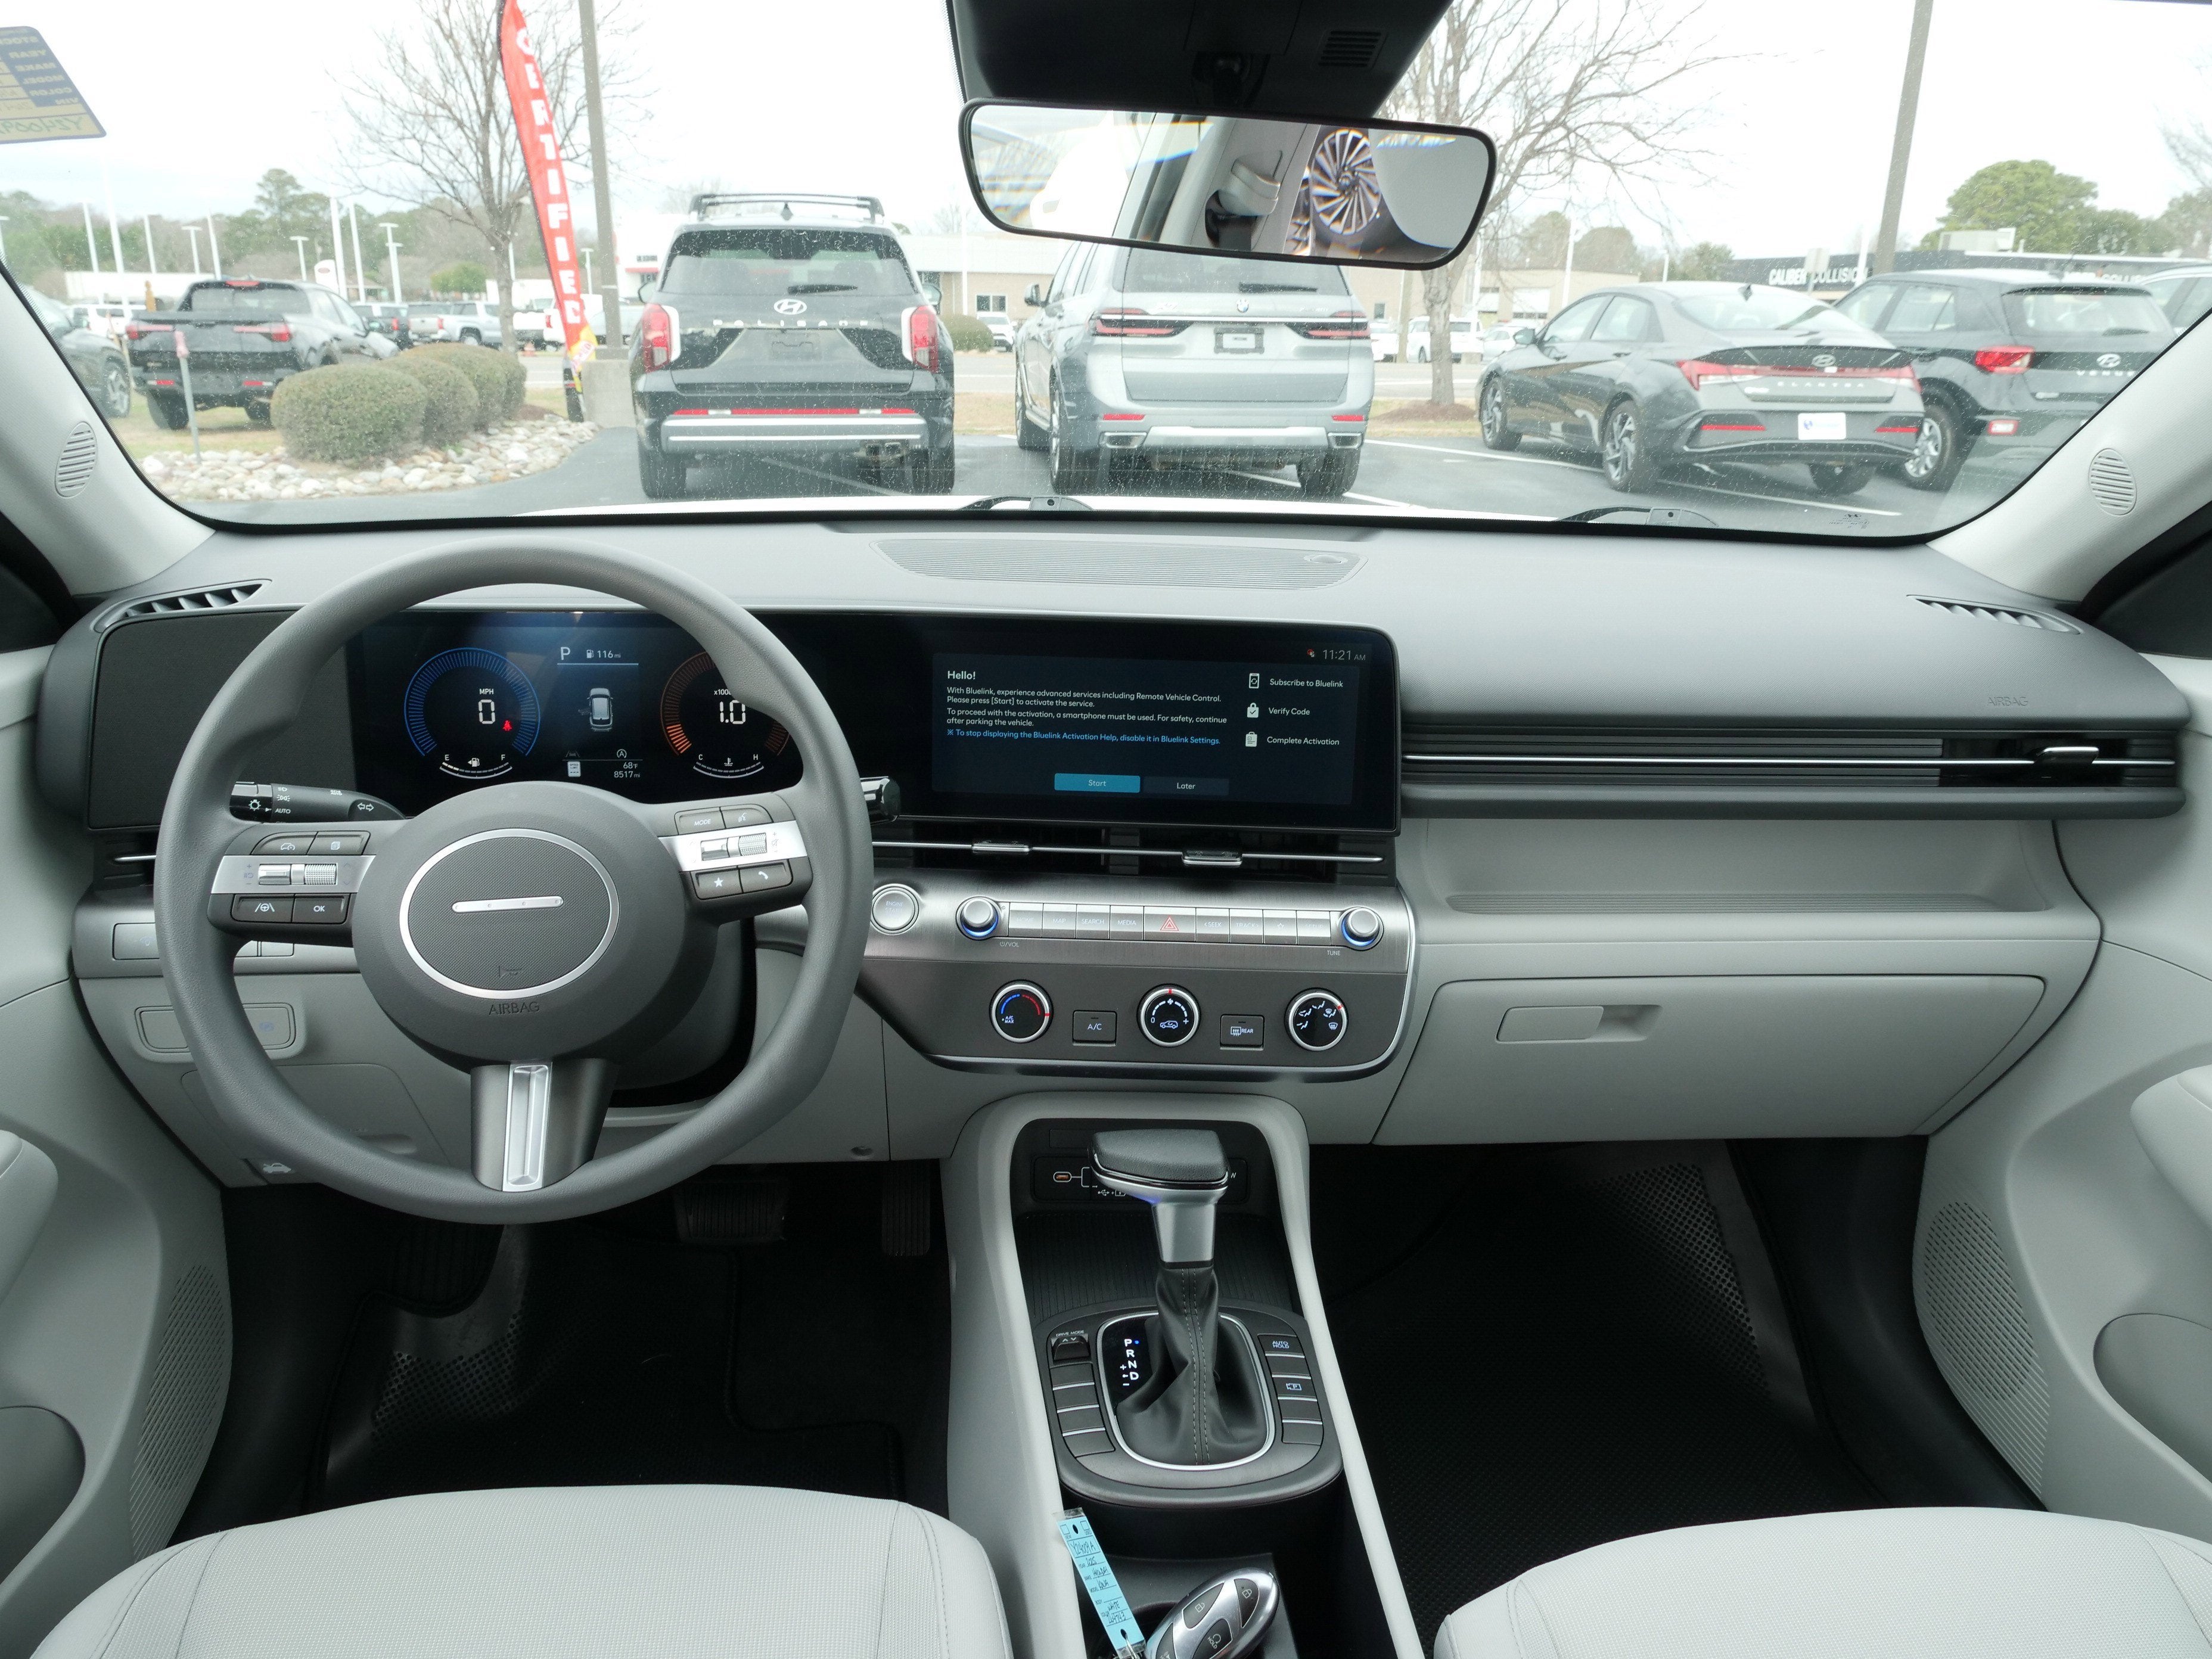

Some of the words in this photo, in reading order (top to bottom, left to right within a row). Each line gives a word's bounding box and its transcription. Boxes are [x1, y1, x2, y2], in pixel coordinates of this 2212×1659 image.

[1769, 268, 1807, 285] CALIBER
[713, 318, 868, 327] PALISADE
[560, 647, 571, 660] P
[1322, 650, 1351, 660] 11:21
[947, 671, 976, 679] Hello!
[997, 689, 1035, 698] experience
[1102, 691, 1135, 700] including
[991, 697, 1014, 706] [Start]
[1988, 697, 2028, 706] AIRBAG
[478, 699, 496, 725] 0
[720, 700, 746, 725] 1.0
[957, 709, 986, 717] proceed
[1062, 712, 1105, 720] smartphone
[1170, 715, 1194, 723] safety,
[1269, 707, 1290, 716] Verify
[966, 718, 993, 726] parking
[983, 730, 1018, 738] displaying
[1190, 736, 1220, 745] Settings.
[1267, 737, 1301, 745] Complete
[489, 1002, 539, 1015] AIRBAG
[1124, 1338, 1132, 1347] P
[1126, 1349, 1135, 1358] R
[1128, 1360, 1138, 1369] N
[1130, 1372, 1139, 1380] D
[1207, 1636, 1218, 1649] HOLD
